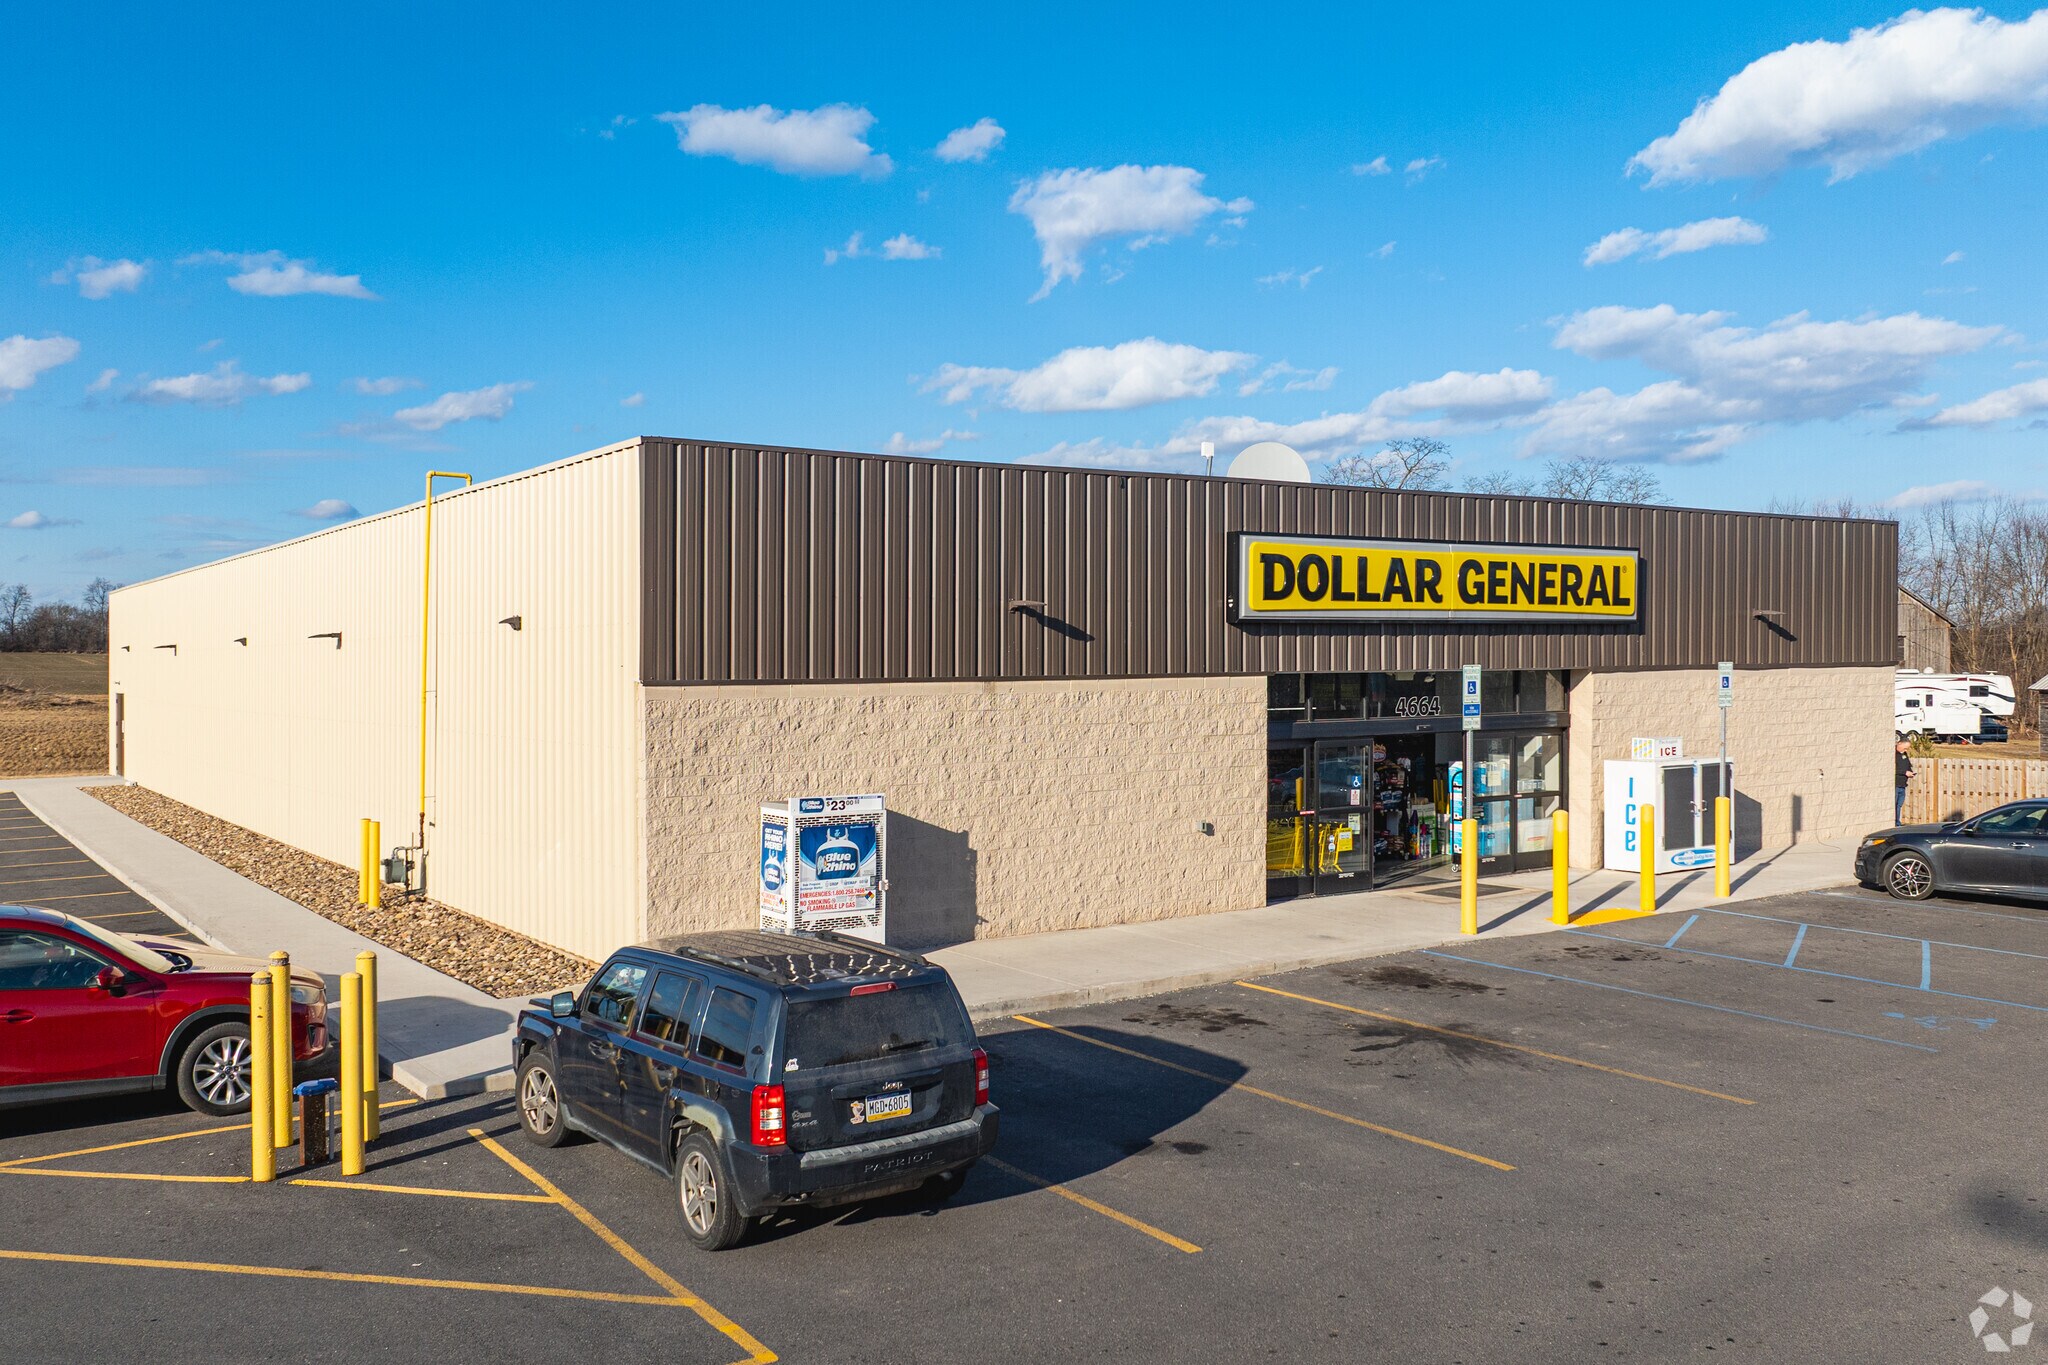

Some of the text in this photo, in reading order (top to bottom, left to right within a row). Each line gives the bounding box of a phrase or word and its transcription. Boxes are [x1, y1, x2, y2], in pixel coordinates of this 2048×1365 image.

[1259, 553, 1443, 603] DOLLAR
[1395, 696, 1441, 717] 4664
[1660, 746, 1677, 757] ICE
[826, 852, 852, 862] Blue
[806, 903, 838, 912] FLAMMABLE
[864, 1151, 933, 1173] PATRIOT
